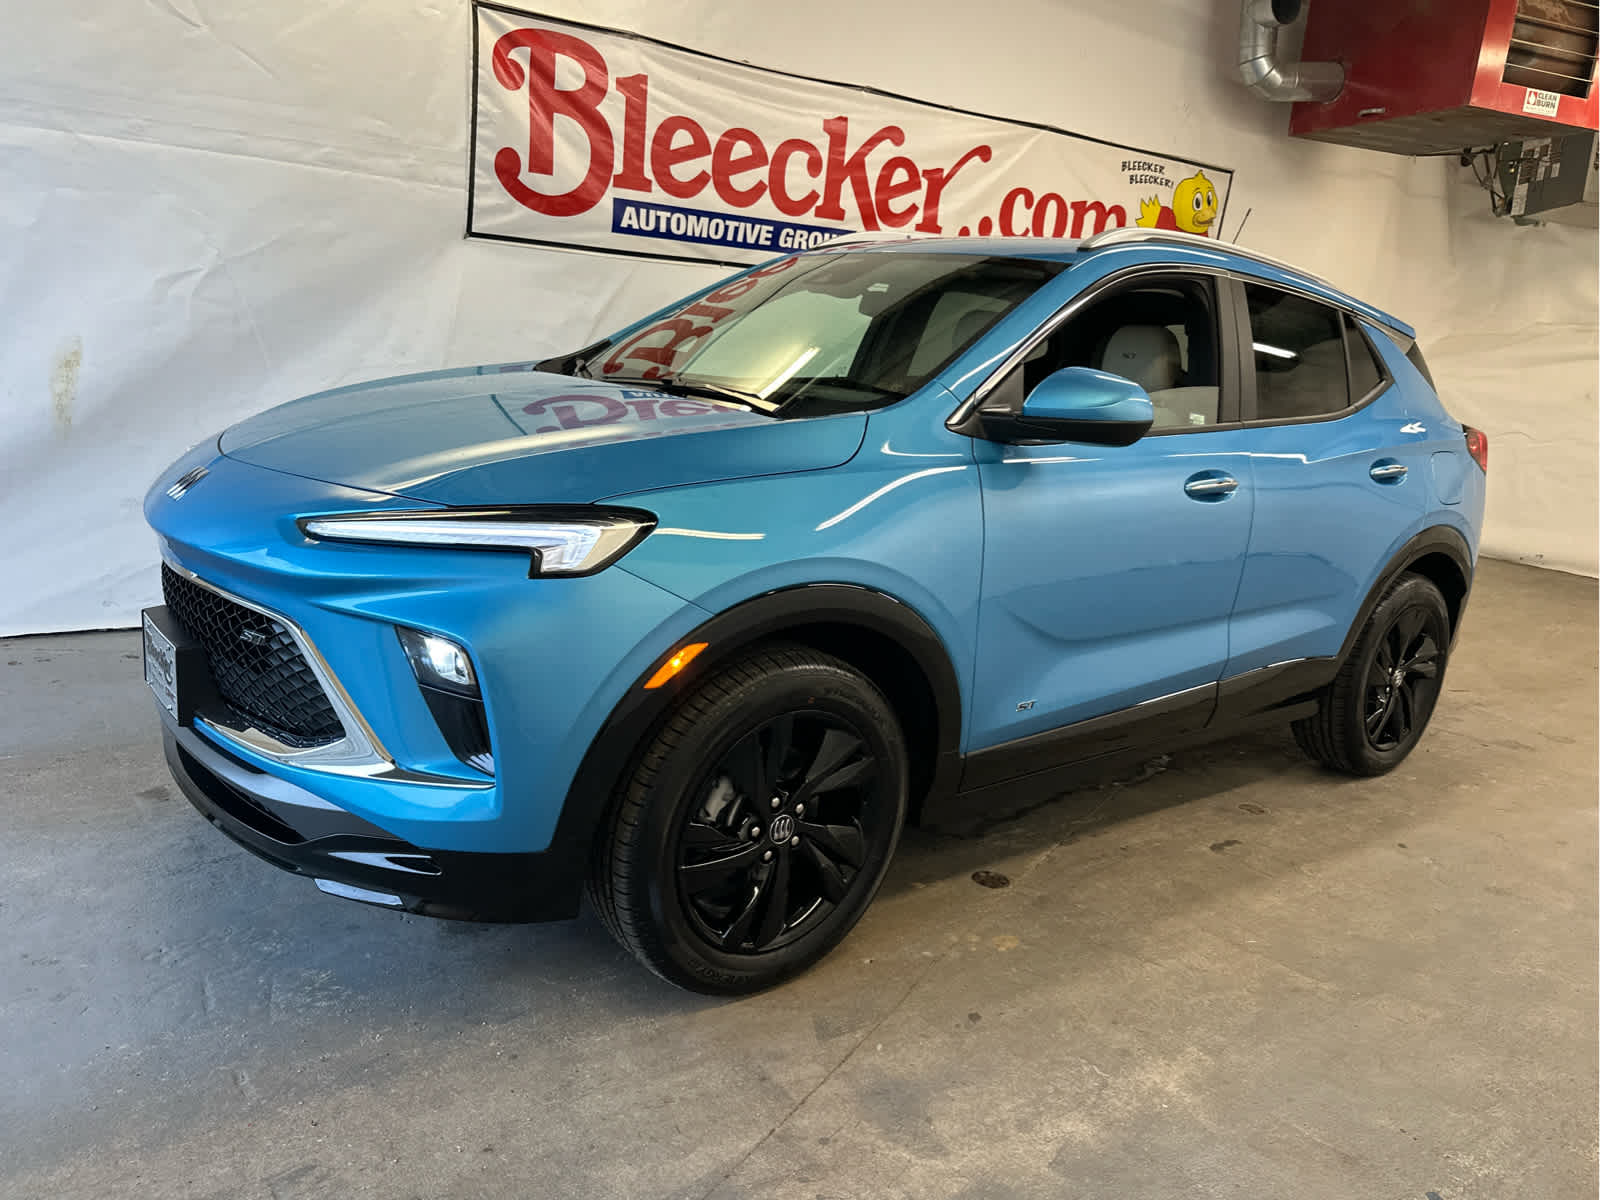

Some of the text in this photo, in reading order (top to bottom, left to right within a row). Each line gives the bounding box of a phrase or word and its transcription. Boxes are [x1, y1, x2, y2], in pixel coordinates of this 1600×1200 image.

[1538, 92, 1558, 102] CLEAN
[1536, 99, 1556, 109] BURN
[620, 206, 775, 246] AUTOMOTIVE
